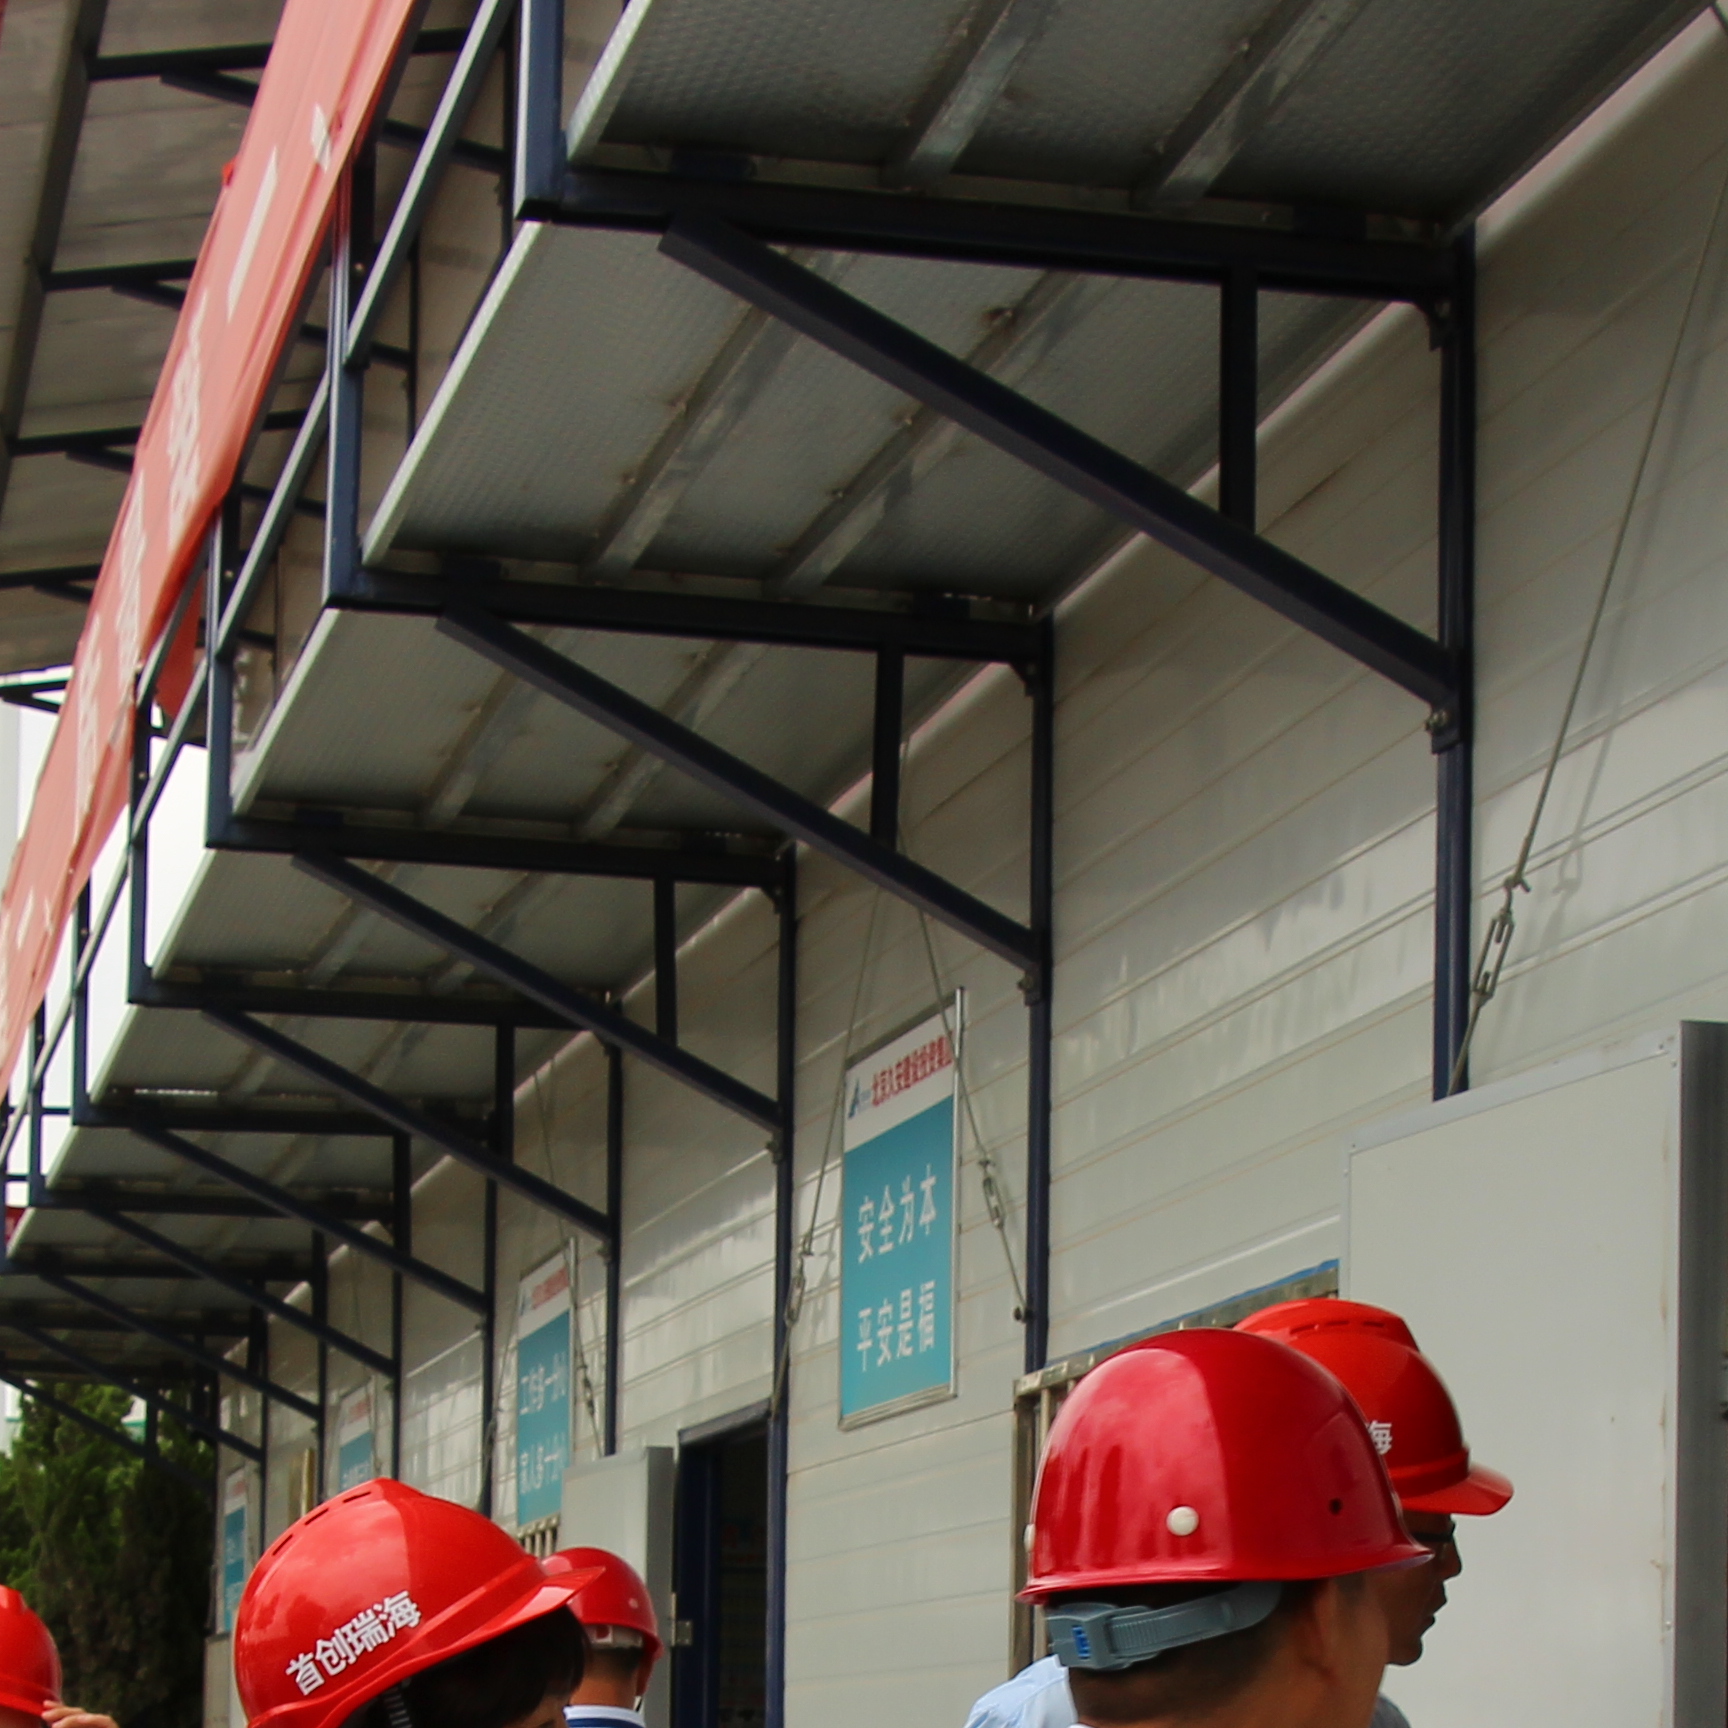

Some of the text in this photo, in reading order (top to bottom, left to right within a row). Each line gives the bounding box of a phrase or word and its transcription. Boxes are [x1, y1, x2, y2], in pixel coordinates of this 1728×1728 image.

[857, 1163, 938, 1264] 安全为本
[856, 1280, 937, 1373] 平安是福
[285, 1590, 422, 1696] 首创瑞海
